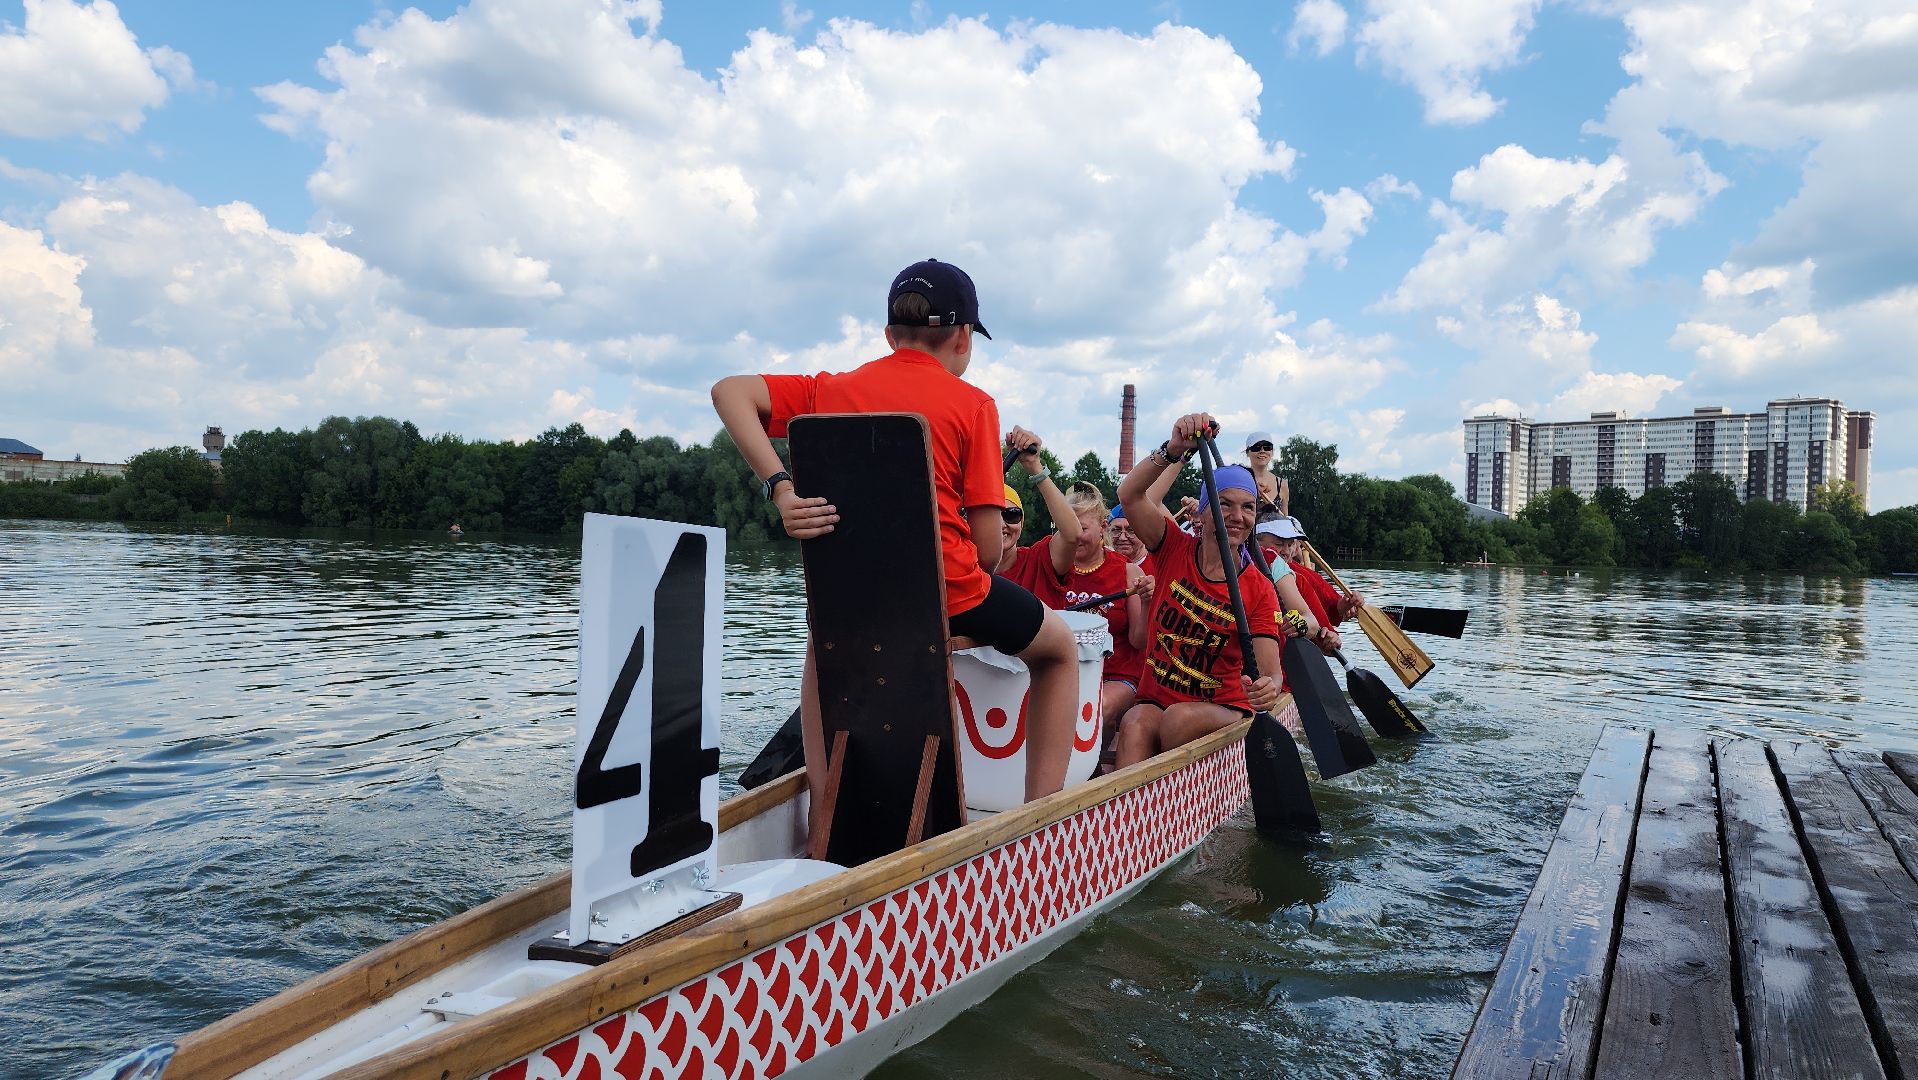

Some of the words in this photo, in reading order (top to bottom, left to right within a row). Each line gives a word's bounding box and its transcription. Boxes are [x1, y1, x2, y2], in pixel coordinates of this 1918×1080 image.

[1156, 600, 1230, 656] FORGET
[1179, 642, 1219, 674] SAY
[577, 532, 720, 878] 4
